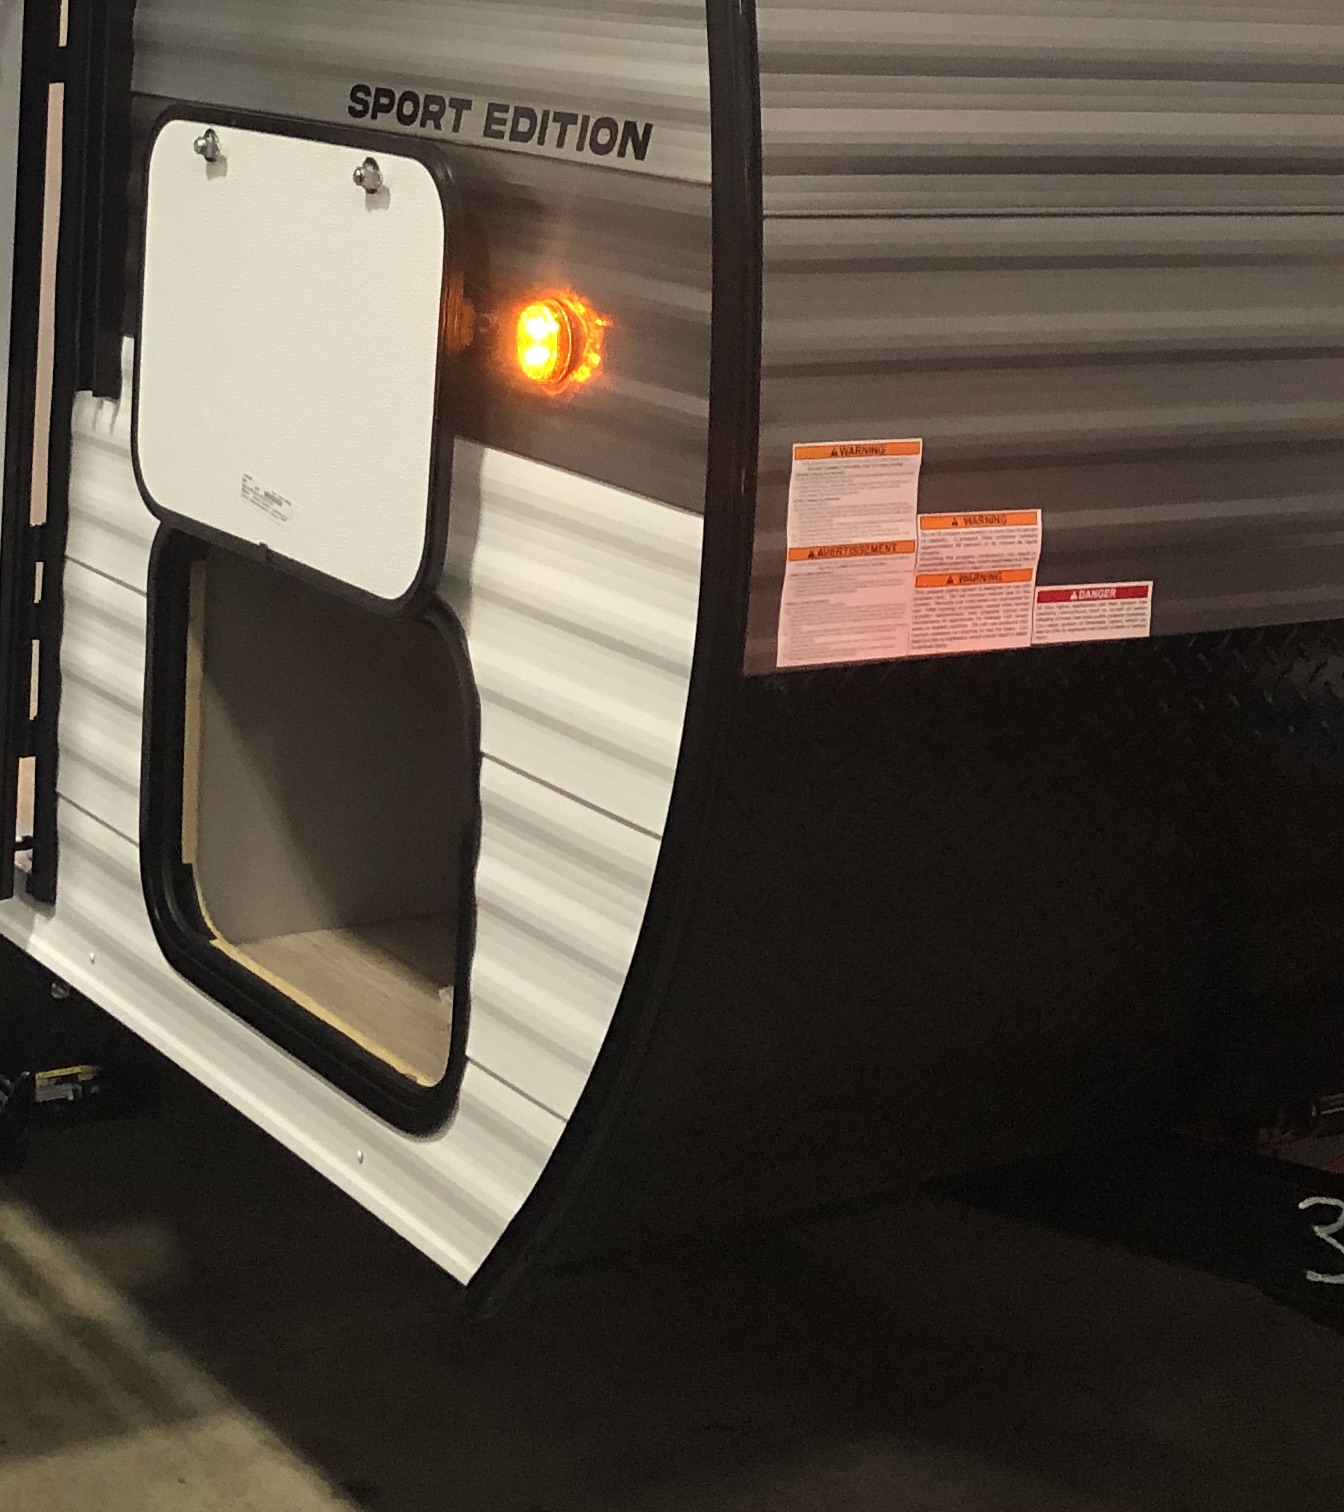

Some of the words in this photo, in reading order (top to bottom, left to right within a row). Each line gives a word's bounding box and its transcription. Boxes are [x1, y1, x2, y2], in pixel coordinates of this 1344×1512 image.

[347, 83, 472, 133] SPORT
[482, 101, 654, 162] EDITION
[840, 444, 886, 456] WARNING
[963, 514, 1008, 526] WARNING
[959, 572, 1003, 583] WARNING
[1078, 588, 1117, 600] DANGER
